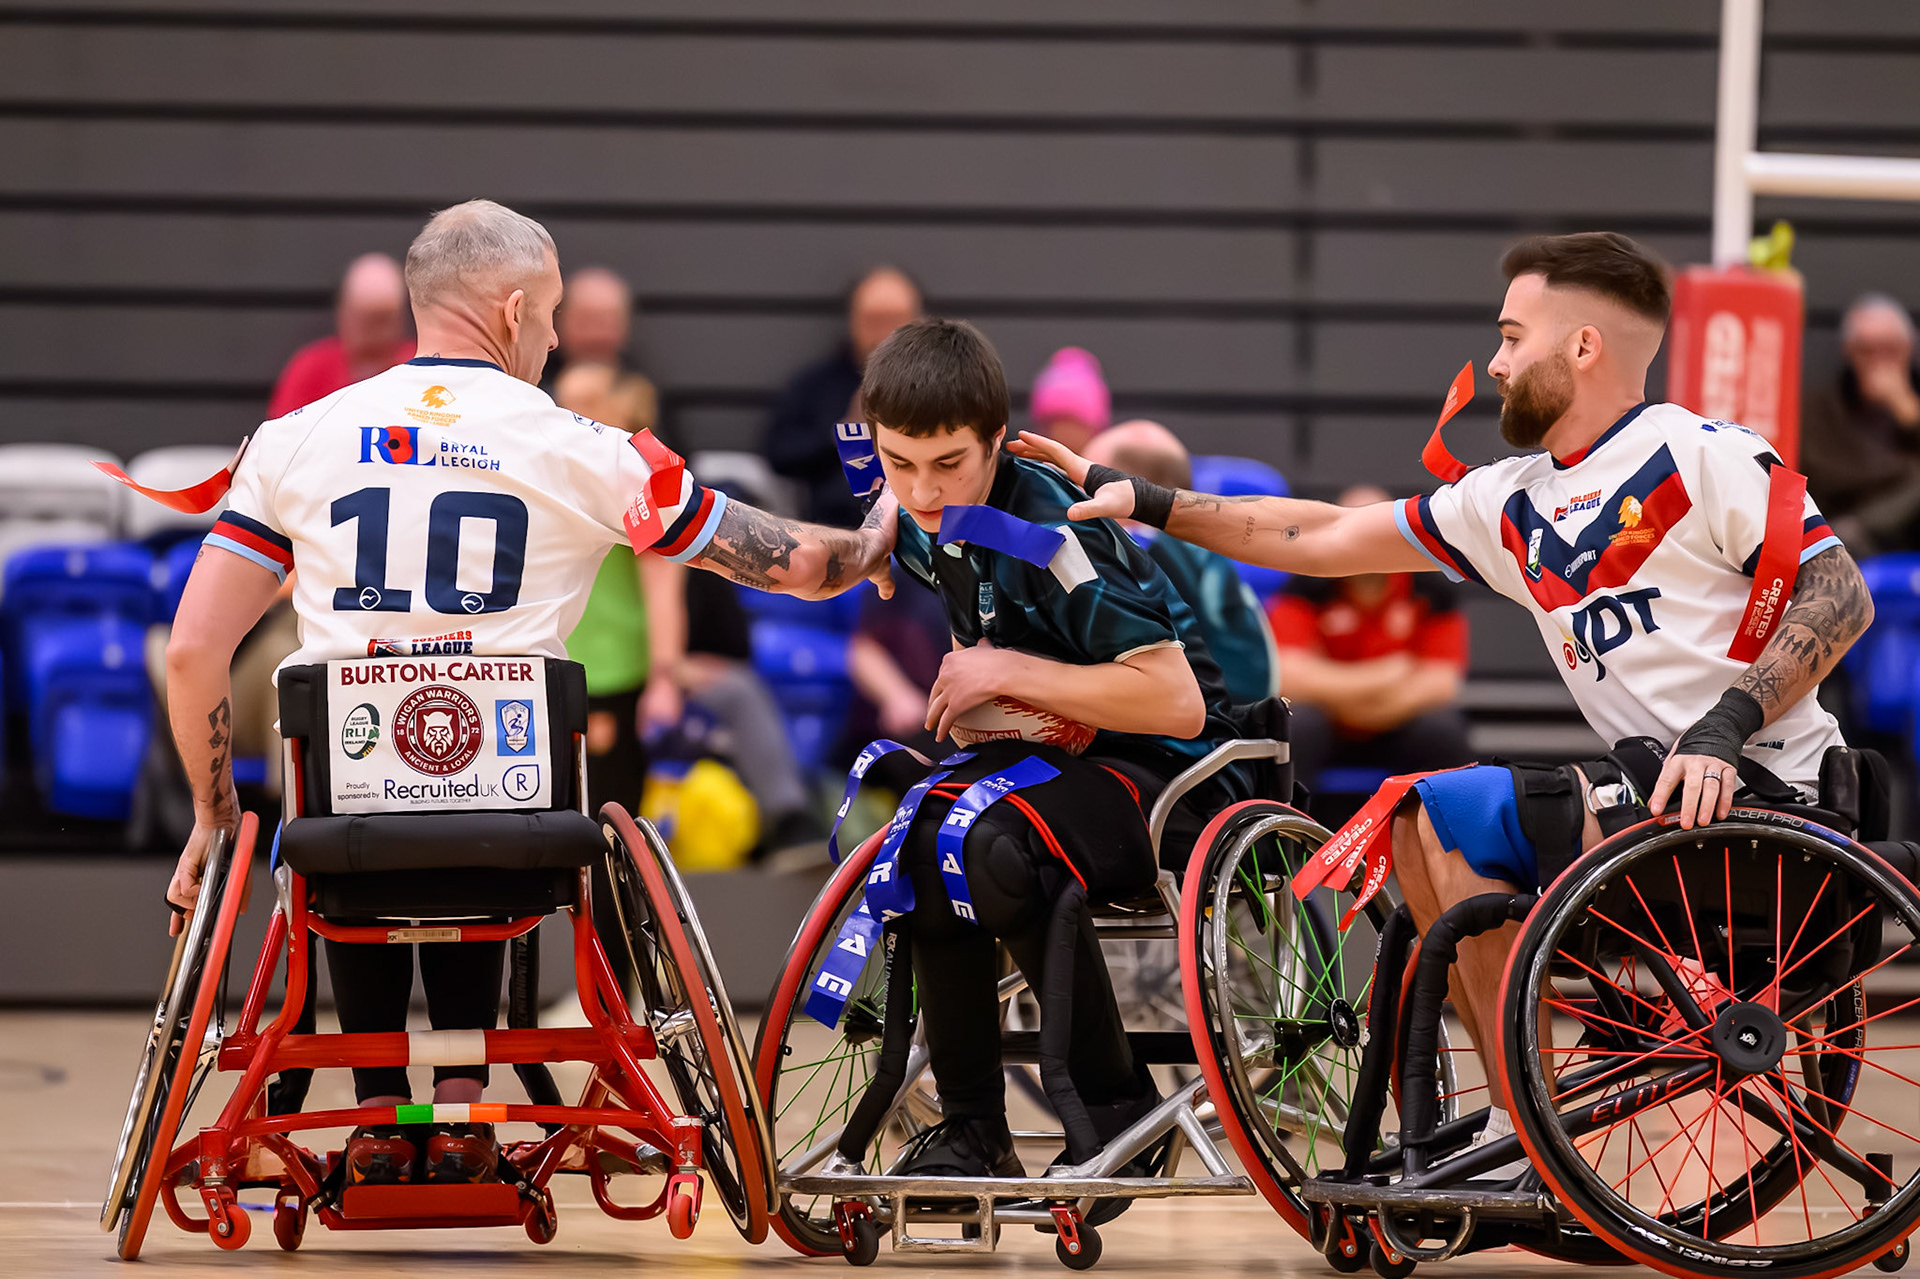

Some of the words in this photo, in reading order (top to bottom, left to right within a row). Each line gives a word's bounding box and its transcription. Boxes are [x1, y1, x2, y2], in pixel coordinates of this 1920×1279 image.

[331, 487, 529, 615] 10
[1755, 577, 1784, 639] CREATED
[411, 641, 473, 655] LEAGUE
[340, 662, 535, 686] BURTON-CARTER
[396, 693, 425, 726] WIGAN
[425, 689, 479, 724] WARRIORS
[345, 728, 366, 738] RLI
[404, 750, 440, 772] ANCIENT
[441, 764, 449, 772] &
[450, 749, 475, 770] LOYAL
[346, 781, 370, 791] Proudly
[516, 773, 529, 792] R
[337, 791, 371, 802] sponsored
[371, 791, 380, 800] by
[1727, 808, 1768, 820] ACER
[1771, 814, 1804, 828] PRO
